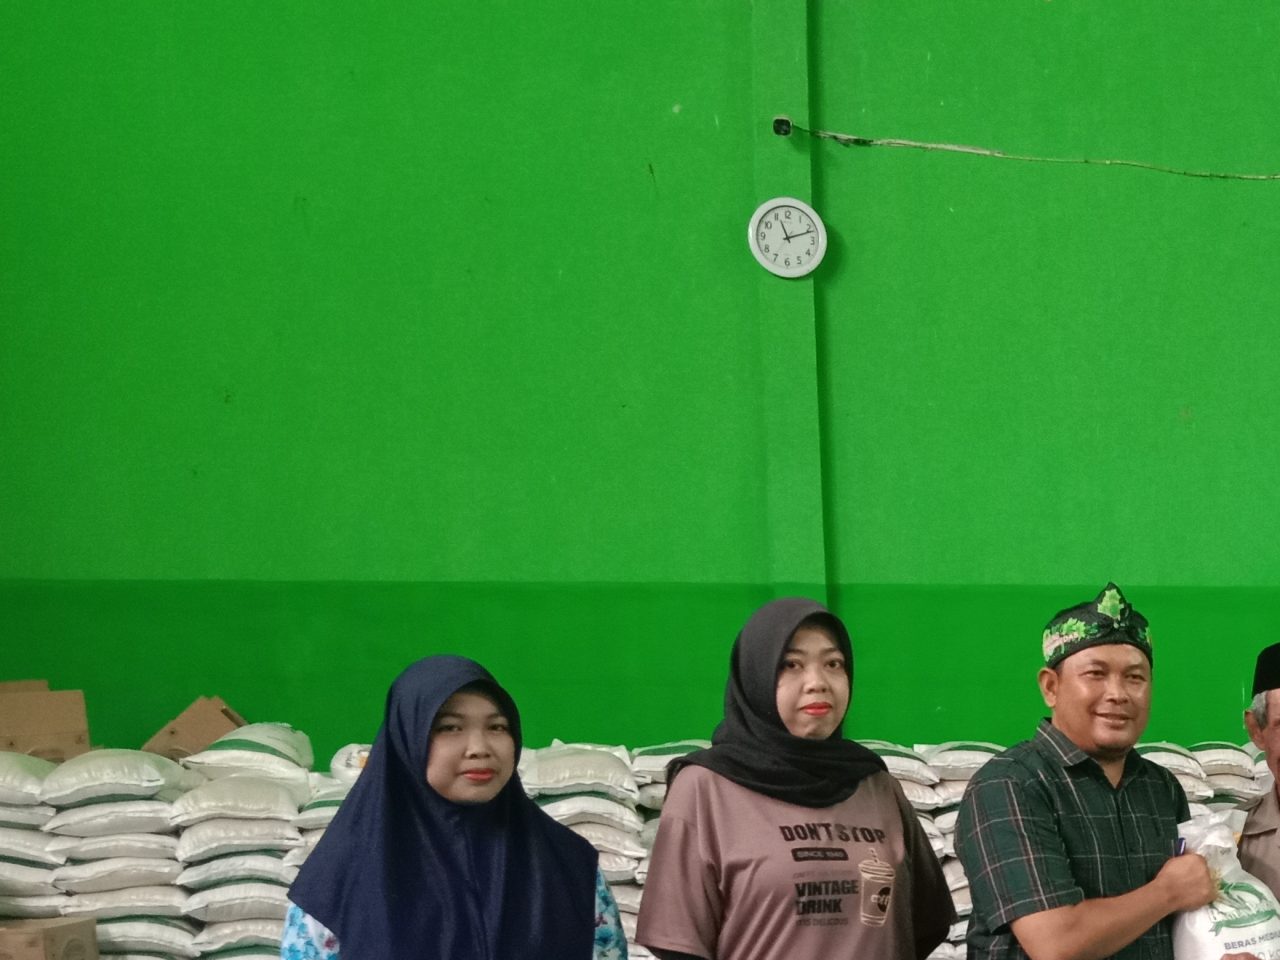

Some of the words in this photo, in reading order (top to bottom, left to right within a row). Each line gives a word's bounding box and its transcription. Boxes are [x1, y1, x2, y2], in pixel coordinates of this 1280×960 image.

[774, 213, 779, 221] 11
[784, 210, 792, 219] 12
[765, 221, 772, 230] 10
[761, 232, 766, 241] 9
[810, 236, 815, 246] 3
[764, 244, 770, 253] 8
[805, 248, 811, 256] 4
[773, 253, 779, 262] 7
[784, 257, 791, 266] 6
[796, 256, 802, 265] 5
[779, 823, 833, 842] DON'T
[834, 823, 886, 843] STOP
[795, 880, 860, 897] VINTAGE
[796, 898, 843, 915] DRINK
[1224, 937, 1257, 950] BERAS
